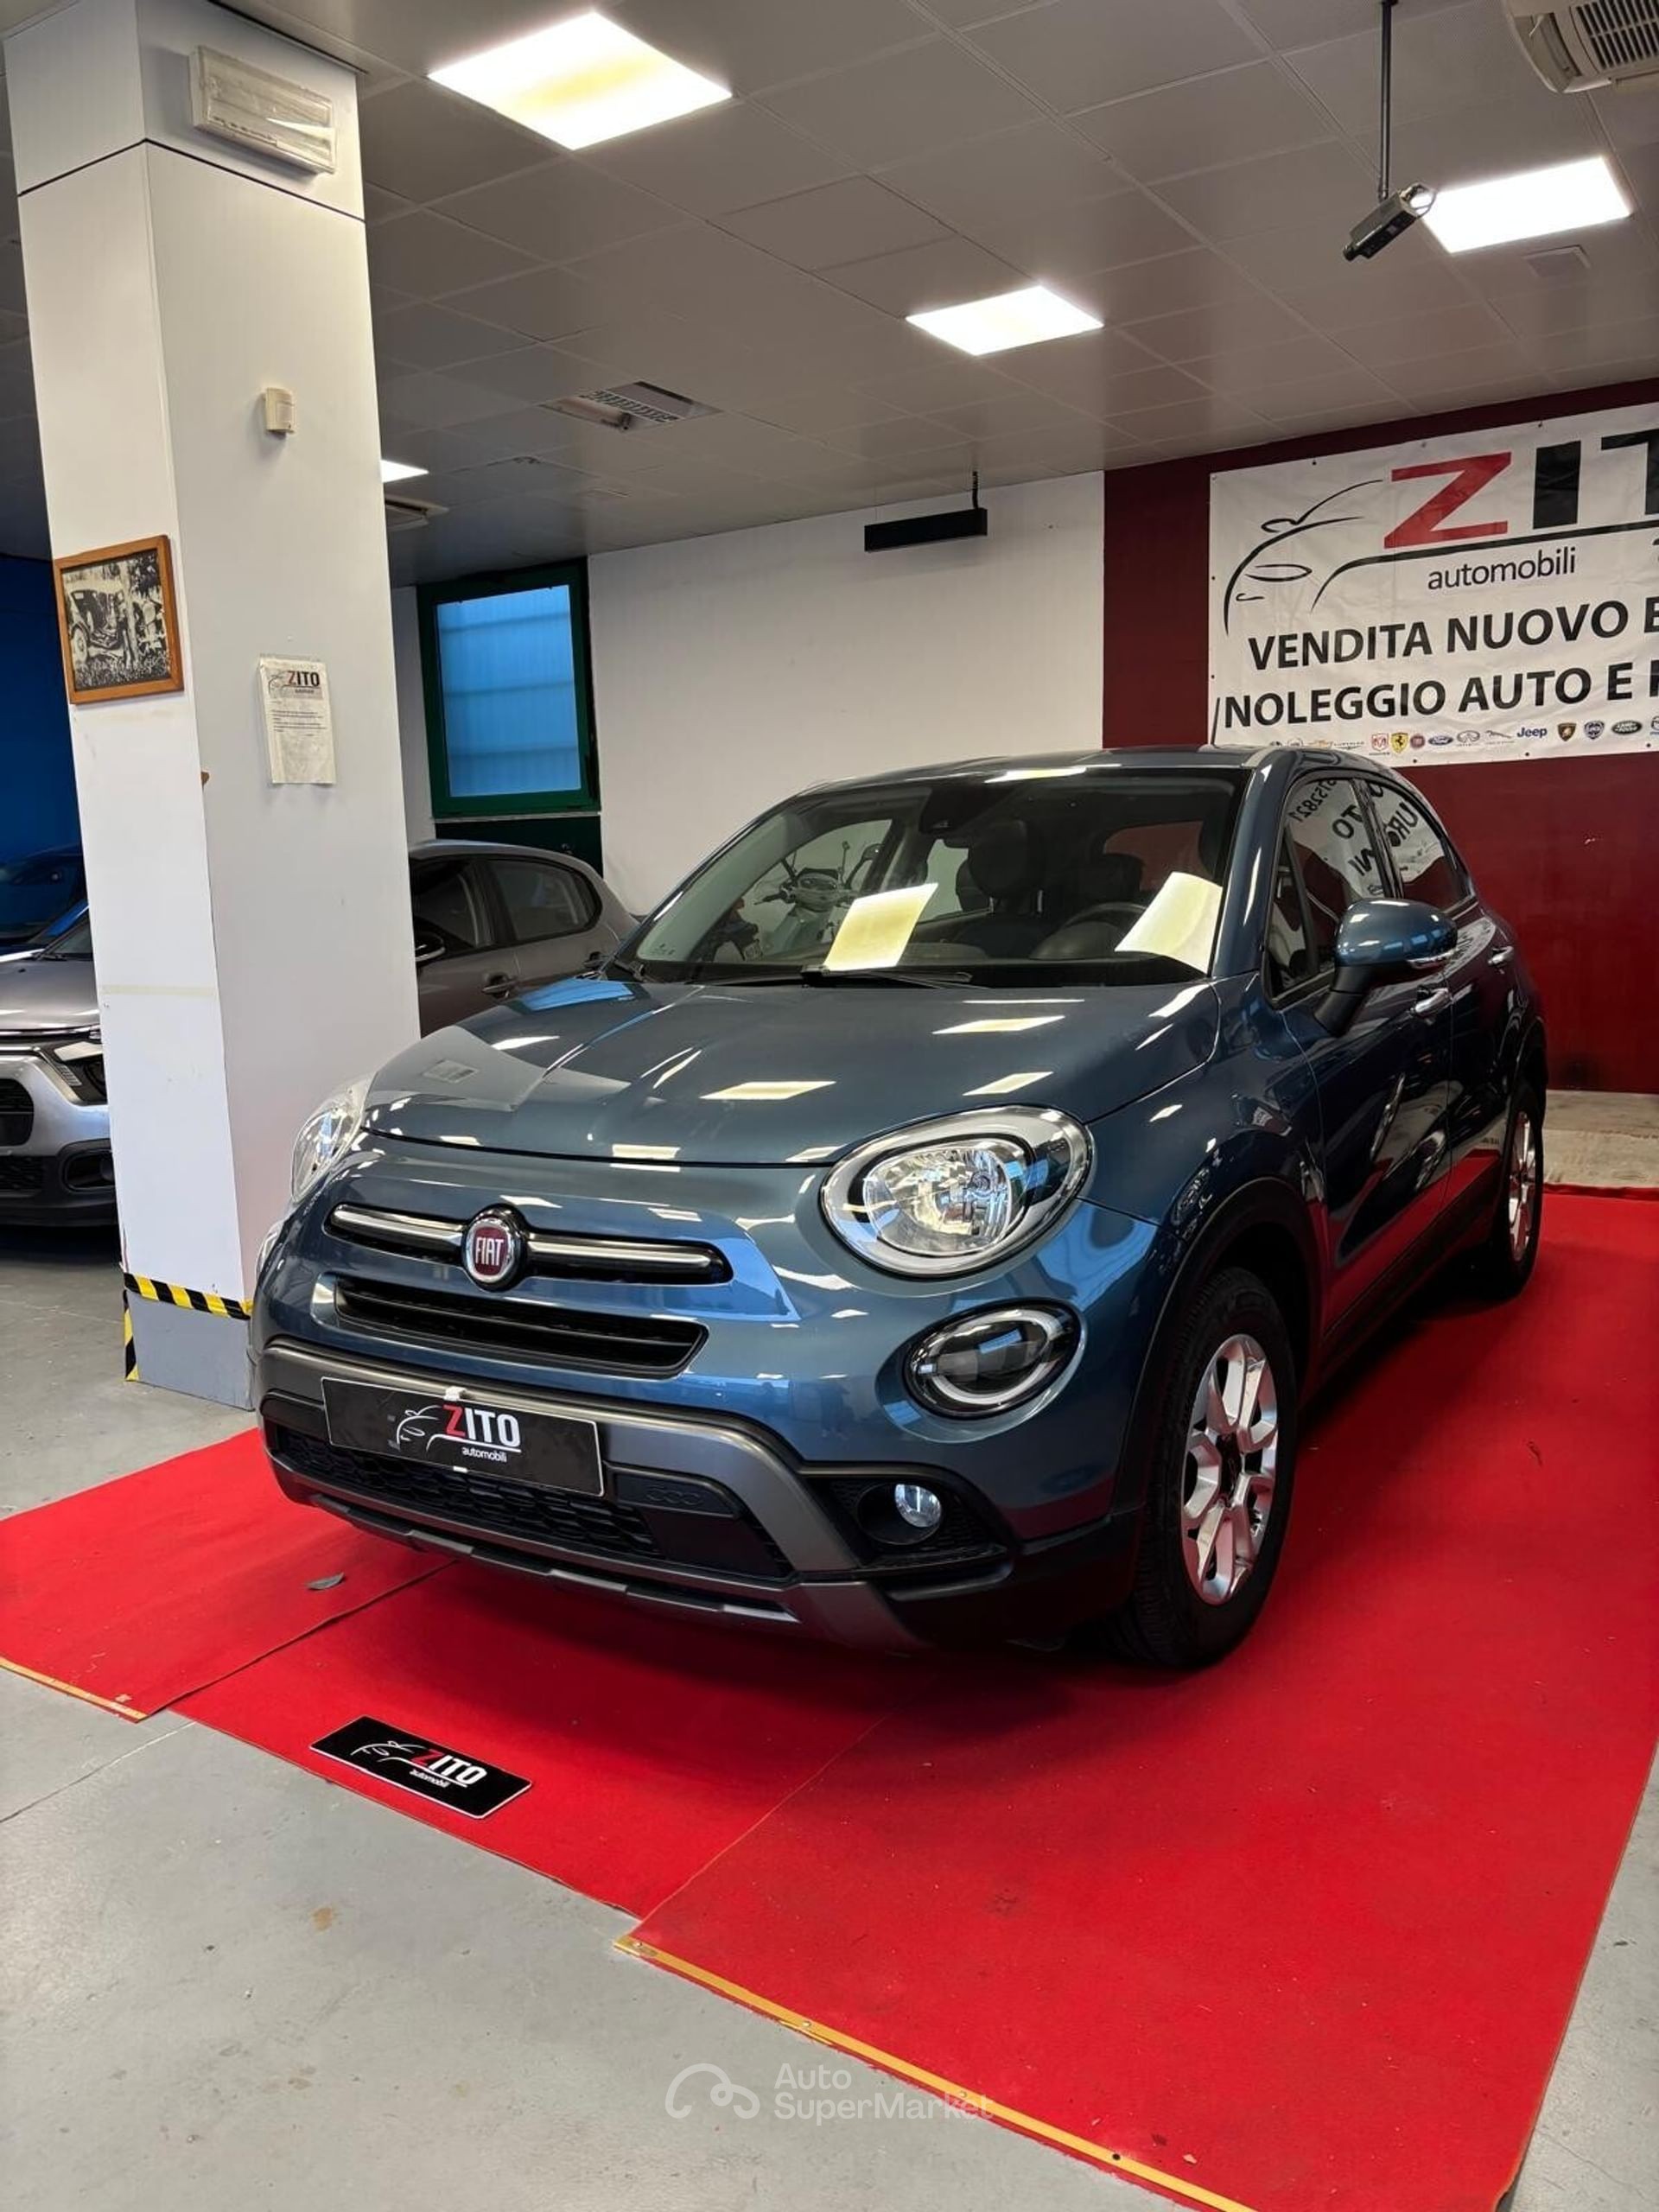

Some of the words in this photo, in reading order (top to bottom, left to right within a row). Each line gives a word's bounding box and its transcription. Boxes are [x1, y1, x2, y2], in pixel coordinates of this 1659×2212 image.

[1428, 546, 1575, 591] automobili
[1248, 621, 1433, 671] VENDITA
[1447, 600, 1629, 653] NUOVO
[288, 670, 321, 688] ZITO
[1224, 680, 1446, 728] NOLEGGIO
[1458, 667, 1592, 713] AUTO
[1607, 662, 1633, 701] E
[1516, 727, 1548, 738] Jeep
[475, 1236, 504, 1266] FIAT
[442, 1404, 521, 1447] ZITO
[461, 1446, 507, 1463] automobili
[410, 1749, 487, 1785] ZITO
